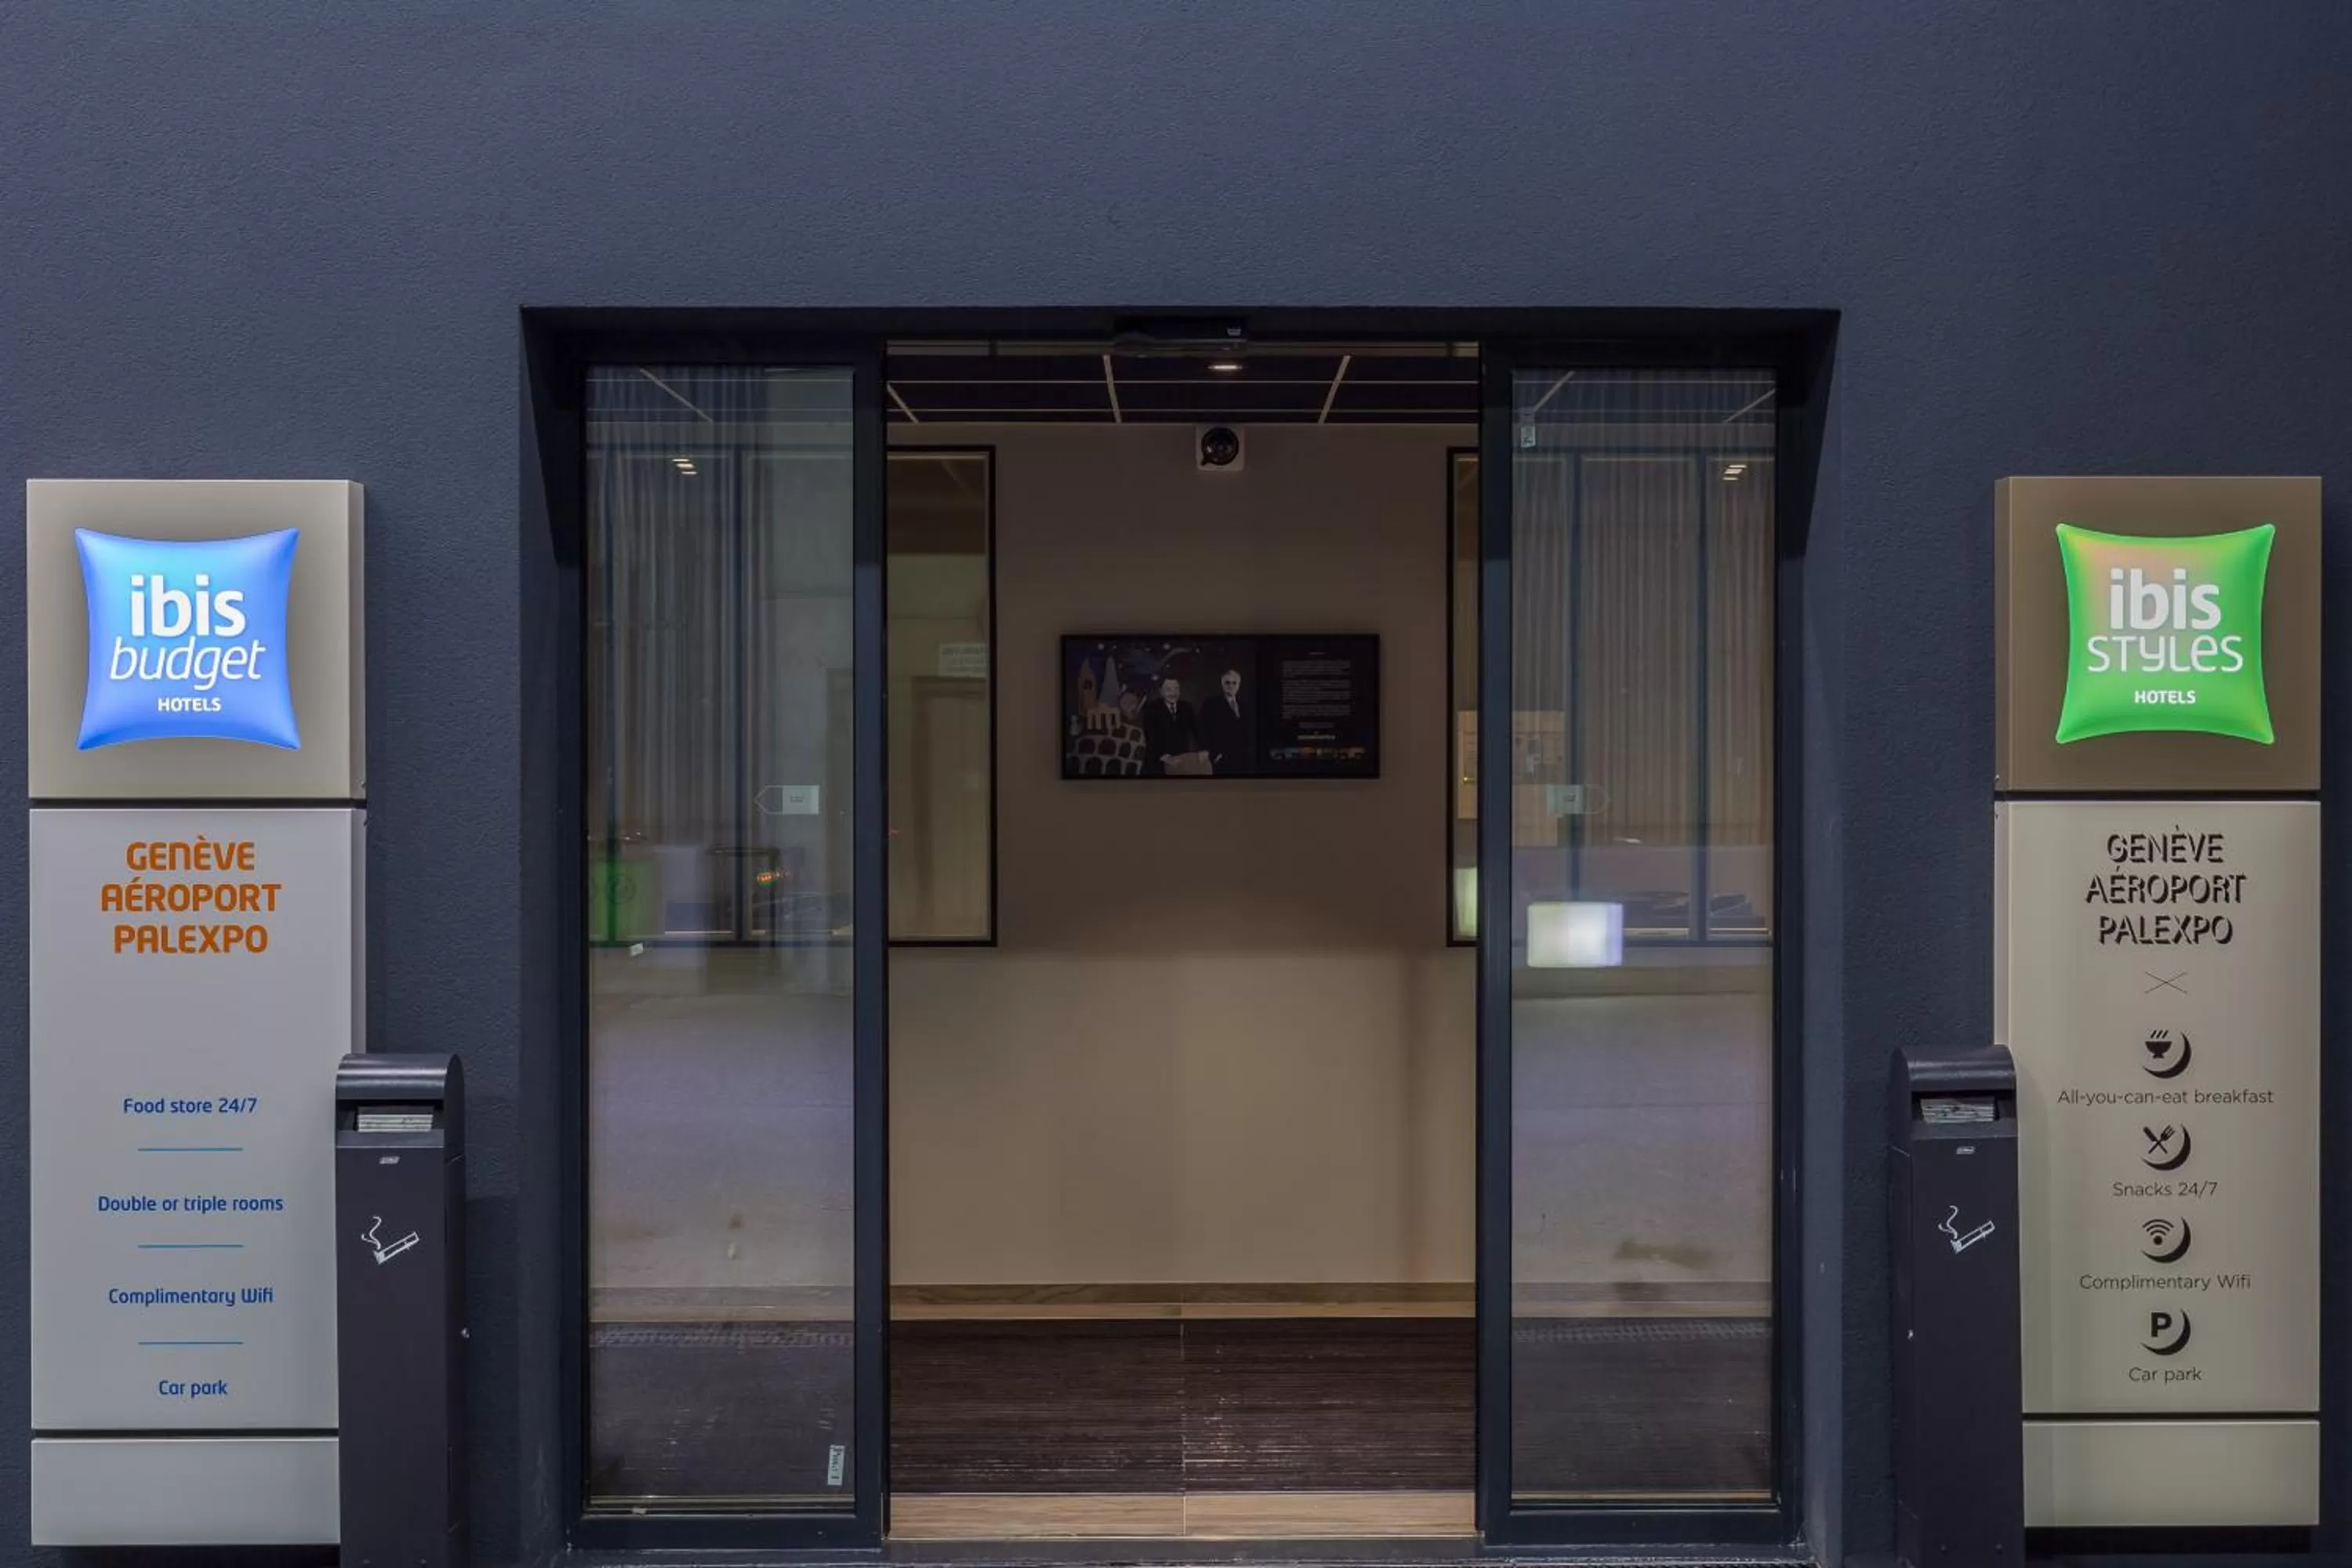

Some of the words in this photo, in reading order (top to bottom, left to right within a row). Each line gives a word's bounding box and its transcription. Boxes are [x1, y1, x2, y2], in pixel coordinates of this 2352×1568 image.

[131, 574, 245, 637] ibis
[2110, 568, 2221, 630] ibis
[110, 634, 266, 691] budget
[158, 697, 221, 712] HOTELS
[2135, 690, 2196, 704] HOTELS
[126, 835, 255, 871] GENÈVE
[2107, 824, 2224, 864] GENÈVE
[100, 876, 281, 913] AÉROPORT
[2085, 865, 2247, 904] AÉROPORT
[114, 924, 268, 954] PALEXPO
[2099, 915, 2234, 945] PALEXPO
[123, 1098, 165, 1114] Food
[169, 1099, 212, 1114] store
[218, 1097, 258, 1113] 24/7
[2057, 1089, 2188, 1107] All-you-can-eat
[2194, 1088, 2274, 1104] breakfast
[2113, 1181, 2172, 1197] Snacks
[2177, 1180, 2218, 1199] 24/7
[98, 1196, 158, 1212] Double
[162, 1199, 179, 1211] or
[183, 1195, 227, 1214] triple
[232, 1198, 284, 1211] rooms
[2079, 1273, 2212, 1292] Complimentary
[2216, 1274, 2251, 1289] Wifi
[108, 1288, 236, 1308] Complimentary
[241, 1287, 274, 1304] Wifi
[2151, 1312, 2172, 1338] P
[2129, 1367, 2158, 1382] Car
[2164, 1367, 2202, 1385] park
[158, 1379, 186, 1396] Car
[191, 1379, 228, 1399] park
